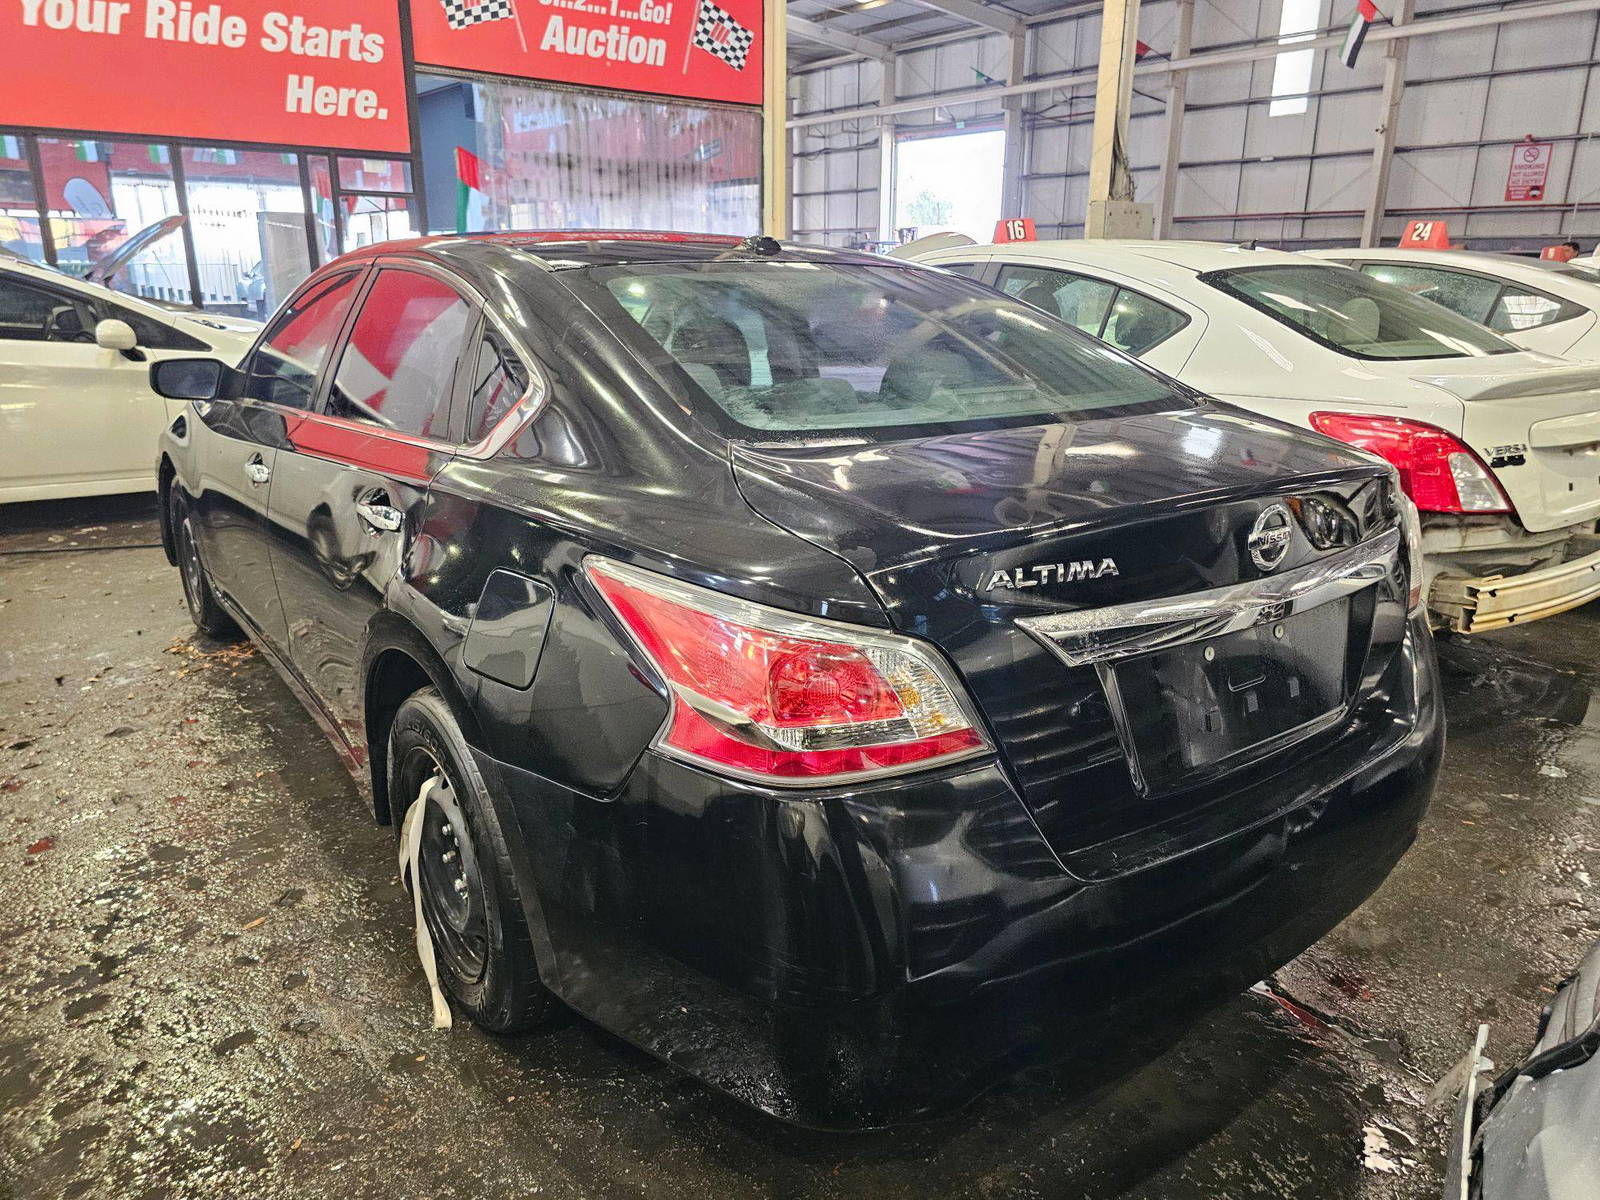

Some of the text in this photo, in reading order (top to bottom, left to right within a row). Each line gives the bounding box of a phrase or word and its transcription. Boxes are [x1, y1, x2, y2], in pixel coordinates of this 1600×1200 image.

[20, 0, 385, 63] Your Ride Starts
[540, 14, 667, 66] Auction
[285, 74, 388, 120] Here.
[1007, 220, 1025, 240] 16
[1411, 222, 1433, 241] 24
[1483, 443, 1528, 457] VERSA
[985, 557, 1120, 592] ALTIMA
